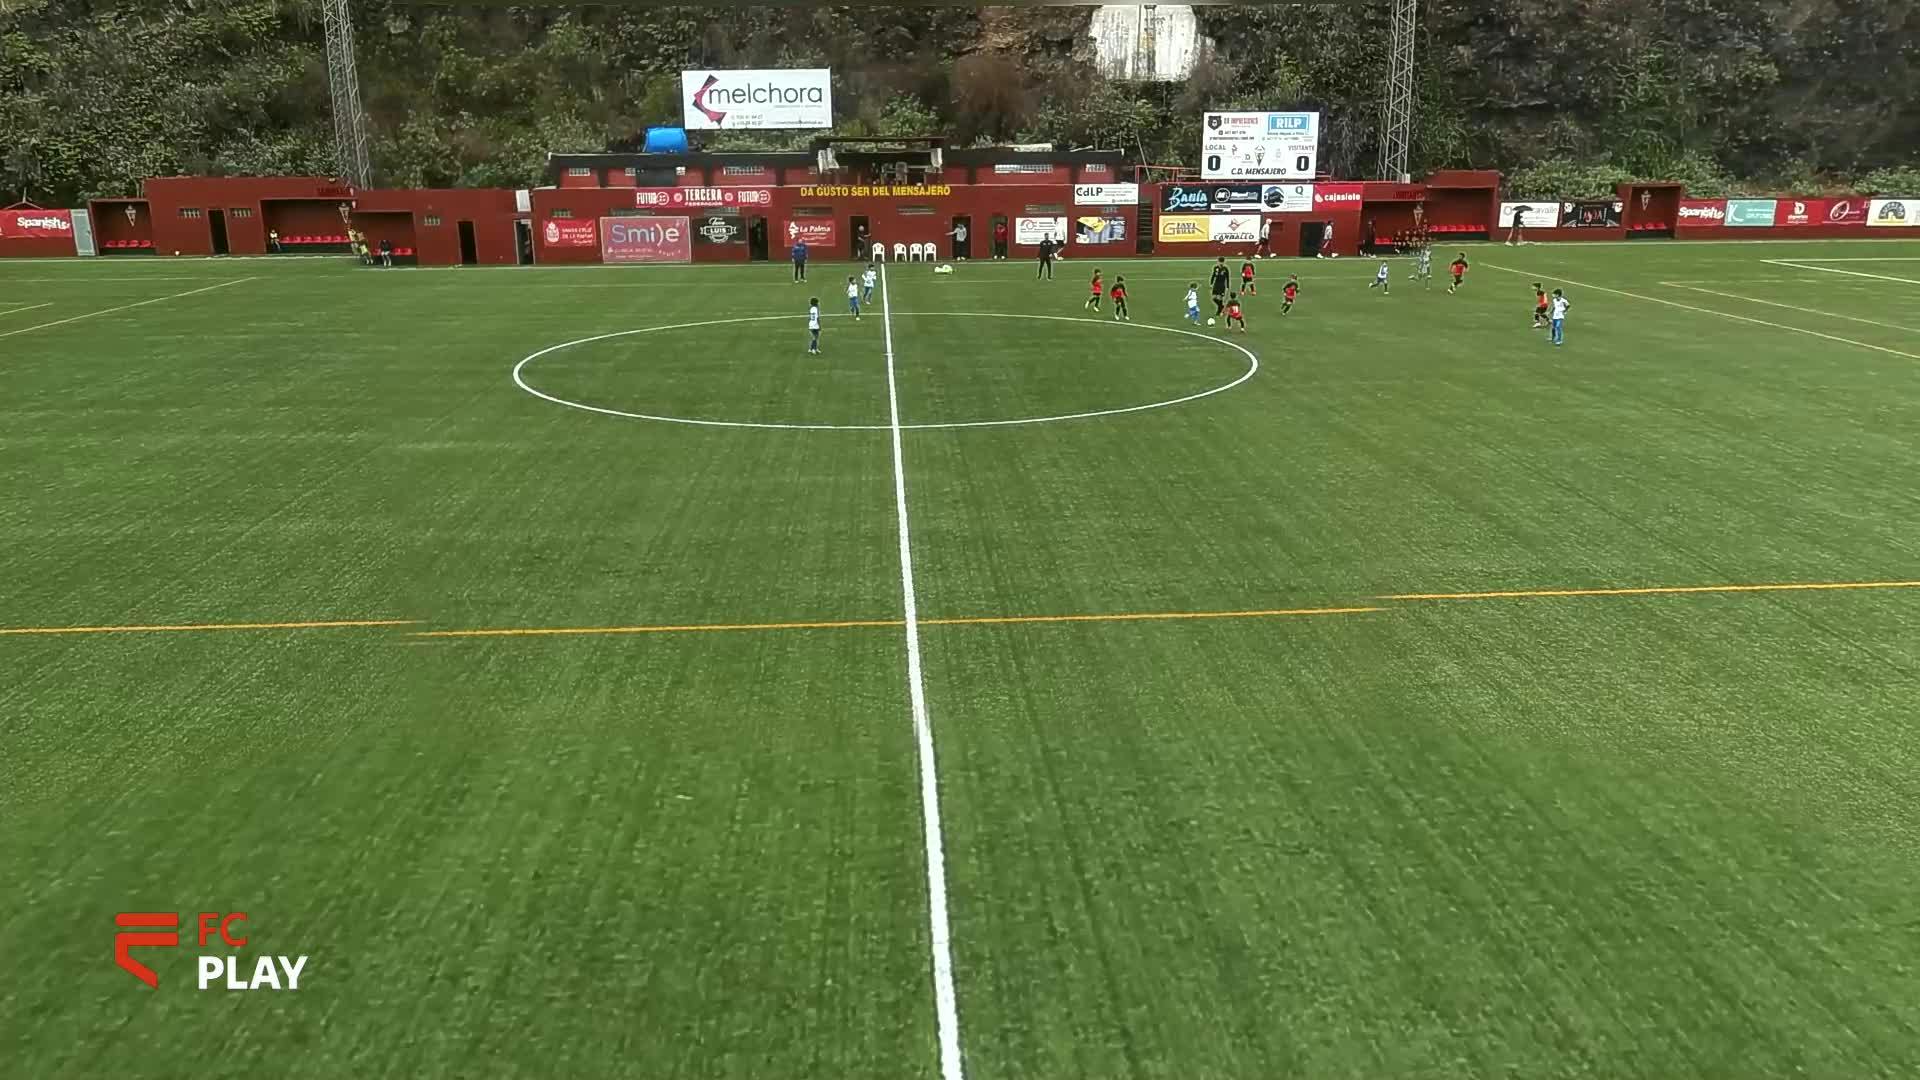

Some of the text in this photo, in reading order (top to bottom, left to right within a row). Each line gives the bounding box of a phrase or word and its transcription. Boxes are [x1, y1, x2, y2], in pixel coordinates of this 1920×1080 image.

[709, 82, 822, 104] melchora
[1276, 117, 1302, 129] RILP
[1207, 155, 1221, 171] 0
[1296, 155, 1309, 171] 0
[684, 189, 722, 201] TERCERA
[801, 185, 951, 197] DA GUSTO SER DEL MENSAJERO
[800, 225, 831, 233] La Palma
